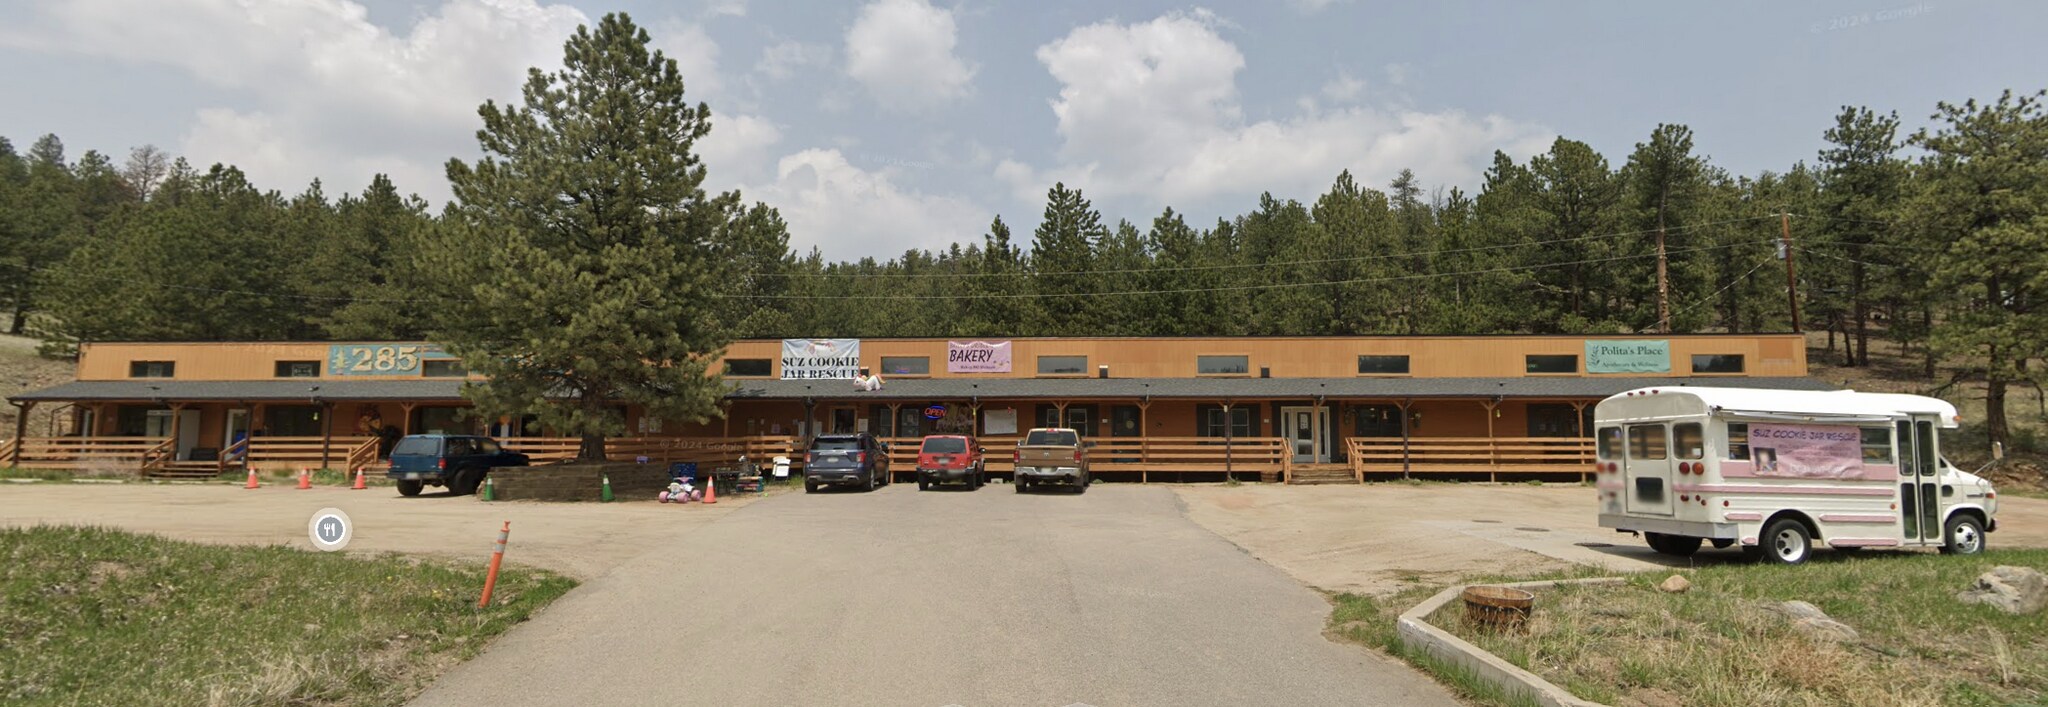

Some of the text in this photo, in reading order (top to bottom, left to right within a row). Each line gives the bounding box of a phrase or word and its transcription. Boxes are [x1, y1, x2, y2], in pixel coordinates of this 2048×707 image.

[949, 349, 994, 363] BAKERY
[1601, 346, 1663, 356] Polita's Place
[350, 346, 418, 372] 285
[781, 357, 859, 367] SUZ COOKIE
[781, 369, 859, 378] JAR RESCUE
[924, 407, 947, 417] OPEN
[1753, 428, 1857, 442] SUZ COOKIE JAR RESCUE
